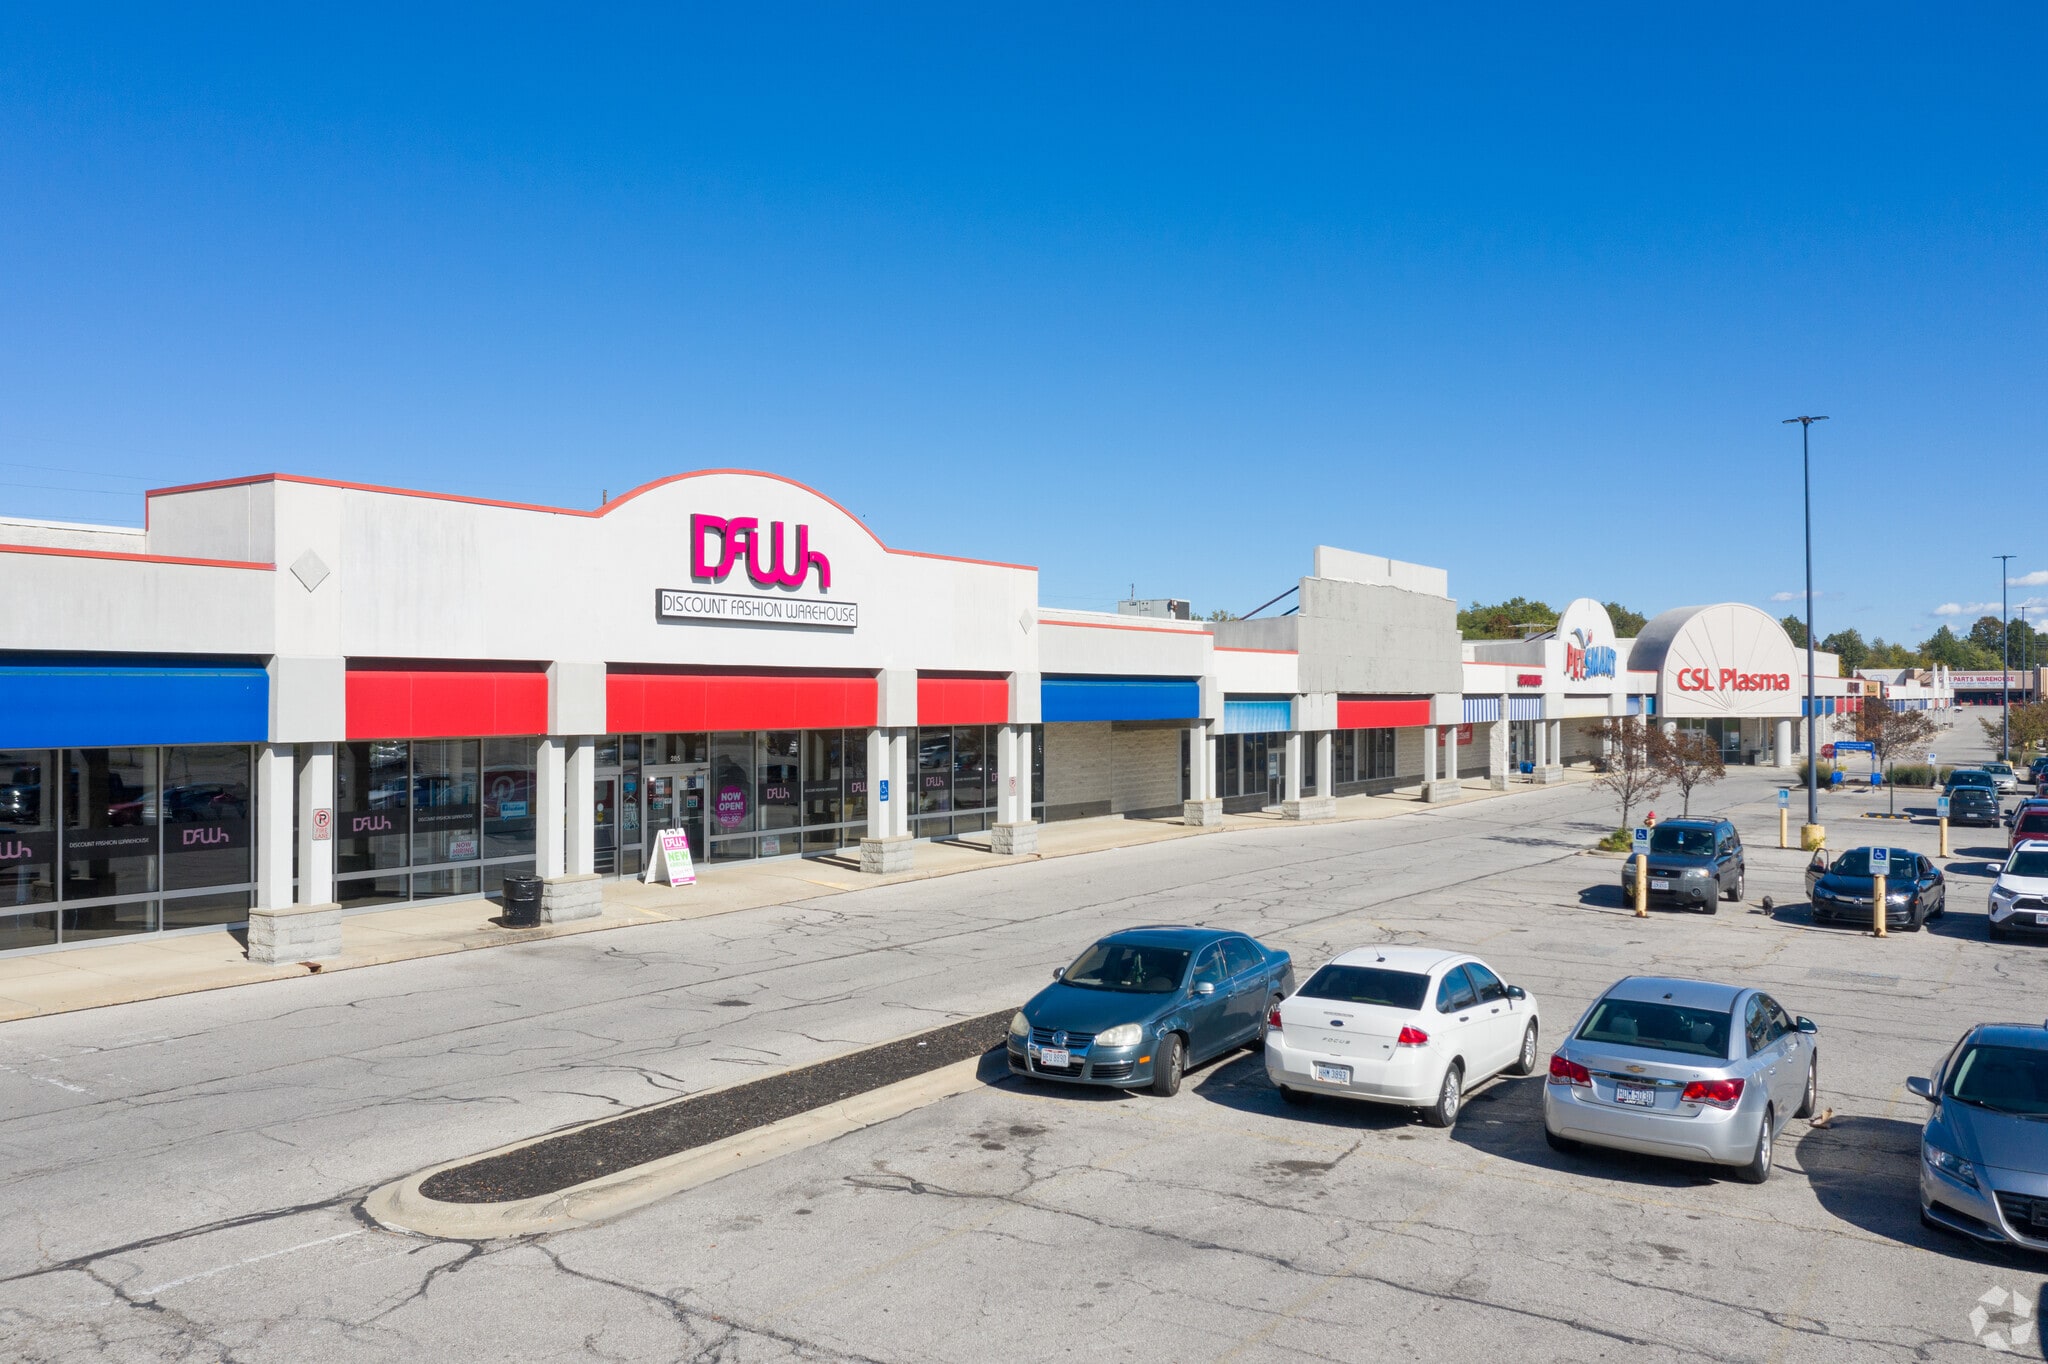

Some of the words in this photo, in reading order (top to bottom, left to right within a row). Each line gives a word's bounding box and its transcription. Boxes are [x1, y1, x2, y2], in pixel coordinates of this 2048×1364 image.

[663, 595, 727, 615] DISCOUNT
[730, 600, 782, 619] FASHION
[785, 602, 855, 622] WAREHOUSE
[1677, 668, 1714, 691] CSL
[1718, 668, 1790, 691] Plasma
[720, 792, 742, 801] NOW
[718, 802, 744, 811] OPEN!
[667, 851, 688, 861] NEW
